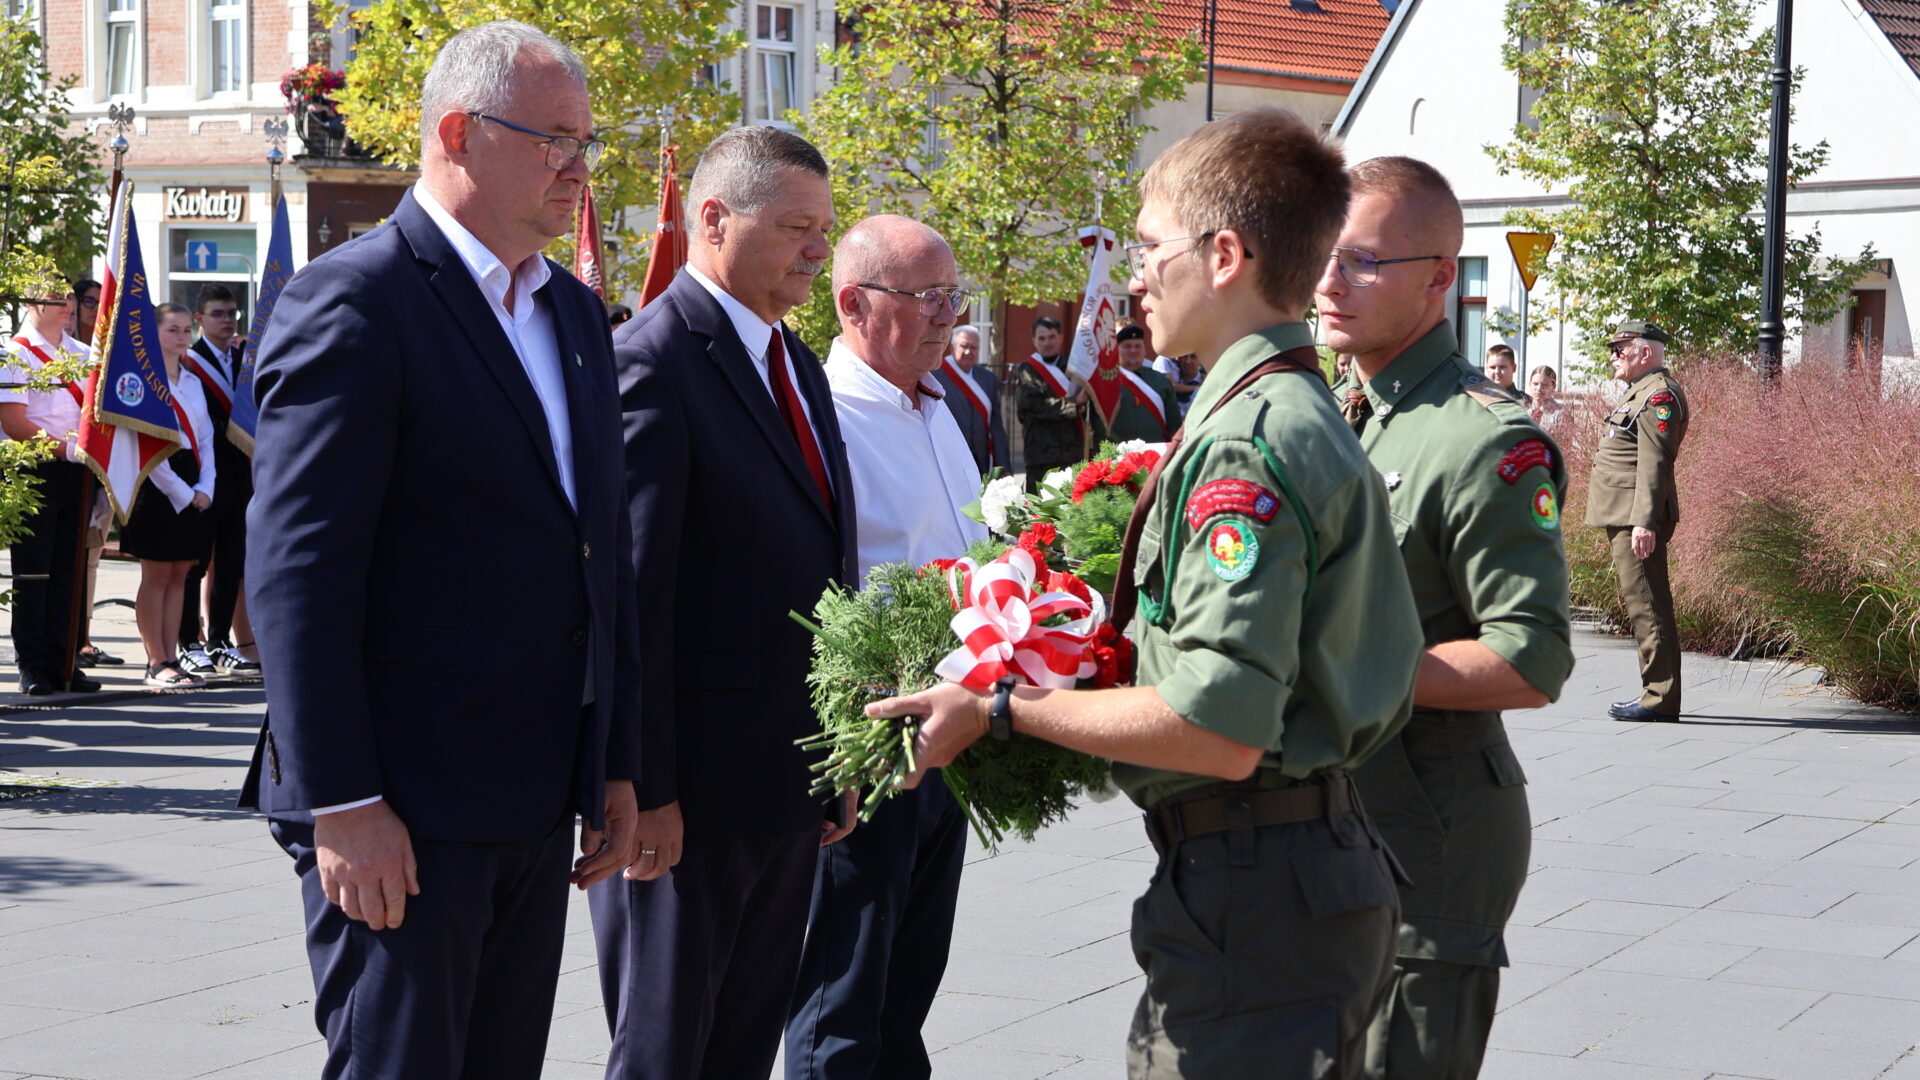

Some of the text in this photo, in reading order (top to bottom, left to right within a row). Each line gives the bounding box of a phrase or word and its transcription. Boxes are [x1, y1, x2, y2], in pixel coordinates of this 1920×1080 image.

[166, 187, 243, 223] Kwiaty
[130, 272, 146, 298] NR
[1081, 295, 1097, 337] HONOR
